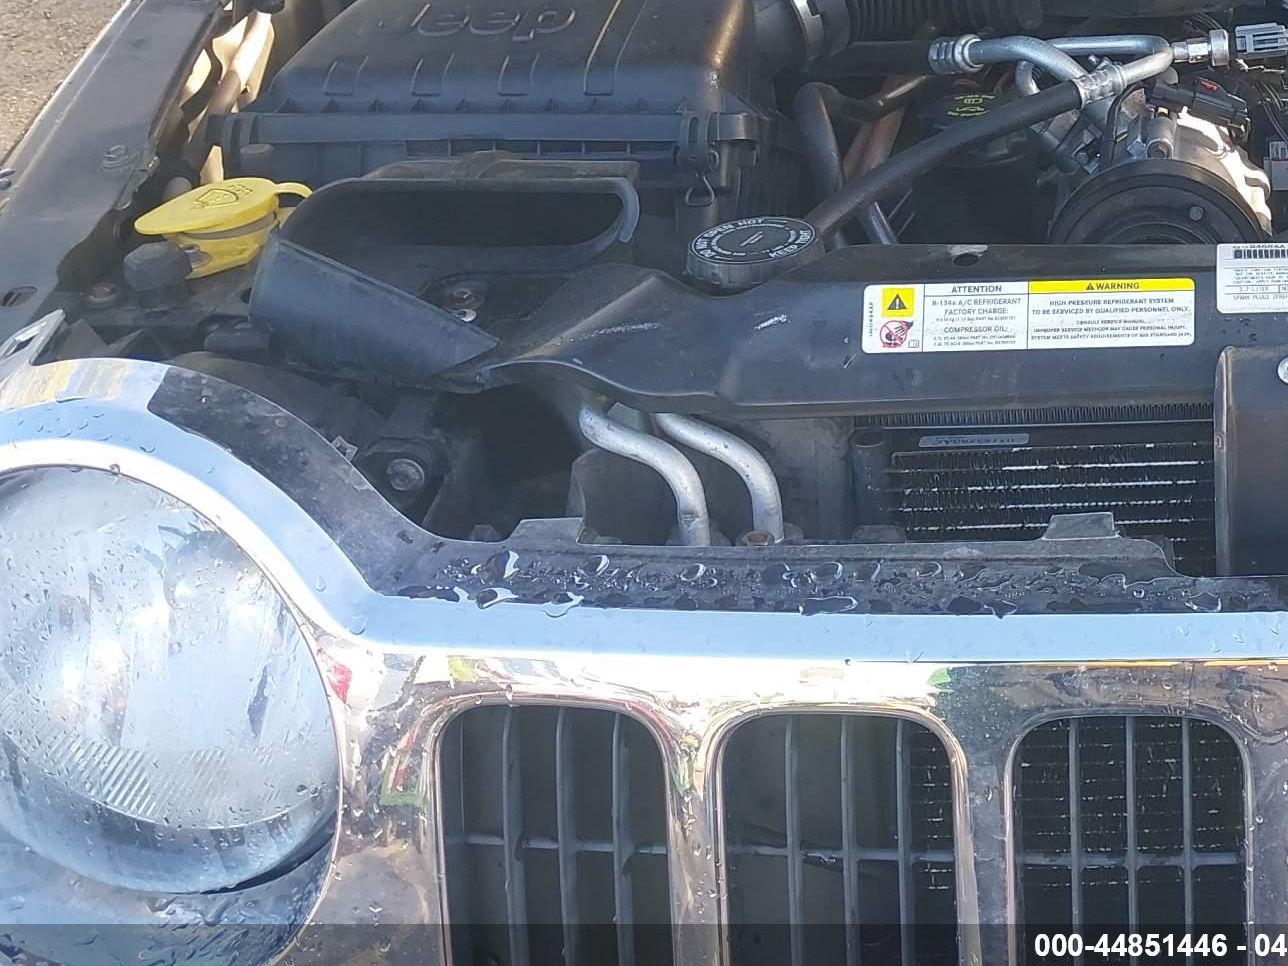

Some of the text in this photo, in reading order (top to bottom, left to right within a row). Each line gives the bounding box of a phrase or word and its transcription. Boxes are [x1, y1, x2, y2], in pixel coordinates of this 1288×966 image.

[362, 2, 577, 42] Jeep
[737, 218, 764, 226] HOT
[951, 284, 1003, 294] ATTENTION
[1096, 282, 1140, 291] WARNING
[957, 298, 973, 306] A/C
[973, 297, 1022, 306] REFRIGERANT
[1049, 299, 1067, 307] HIGH
[1068, 298, 1102, 306] PRESSURE
[1148, 297, 1175, 305] SYSTEM
[944, 307, 1009, 317] FACTORY CHARGE:
[943, 325, 1008, 334] COMPRESSOR OIL:
